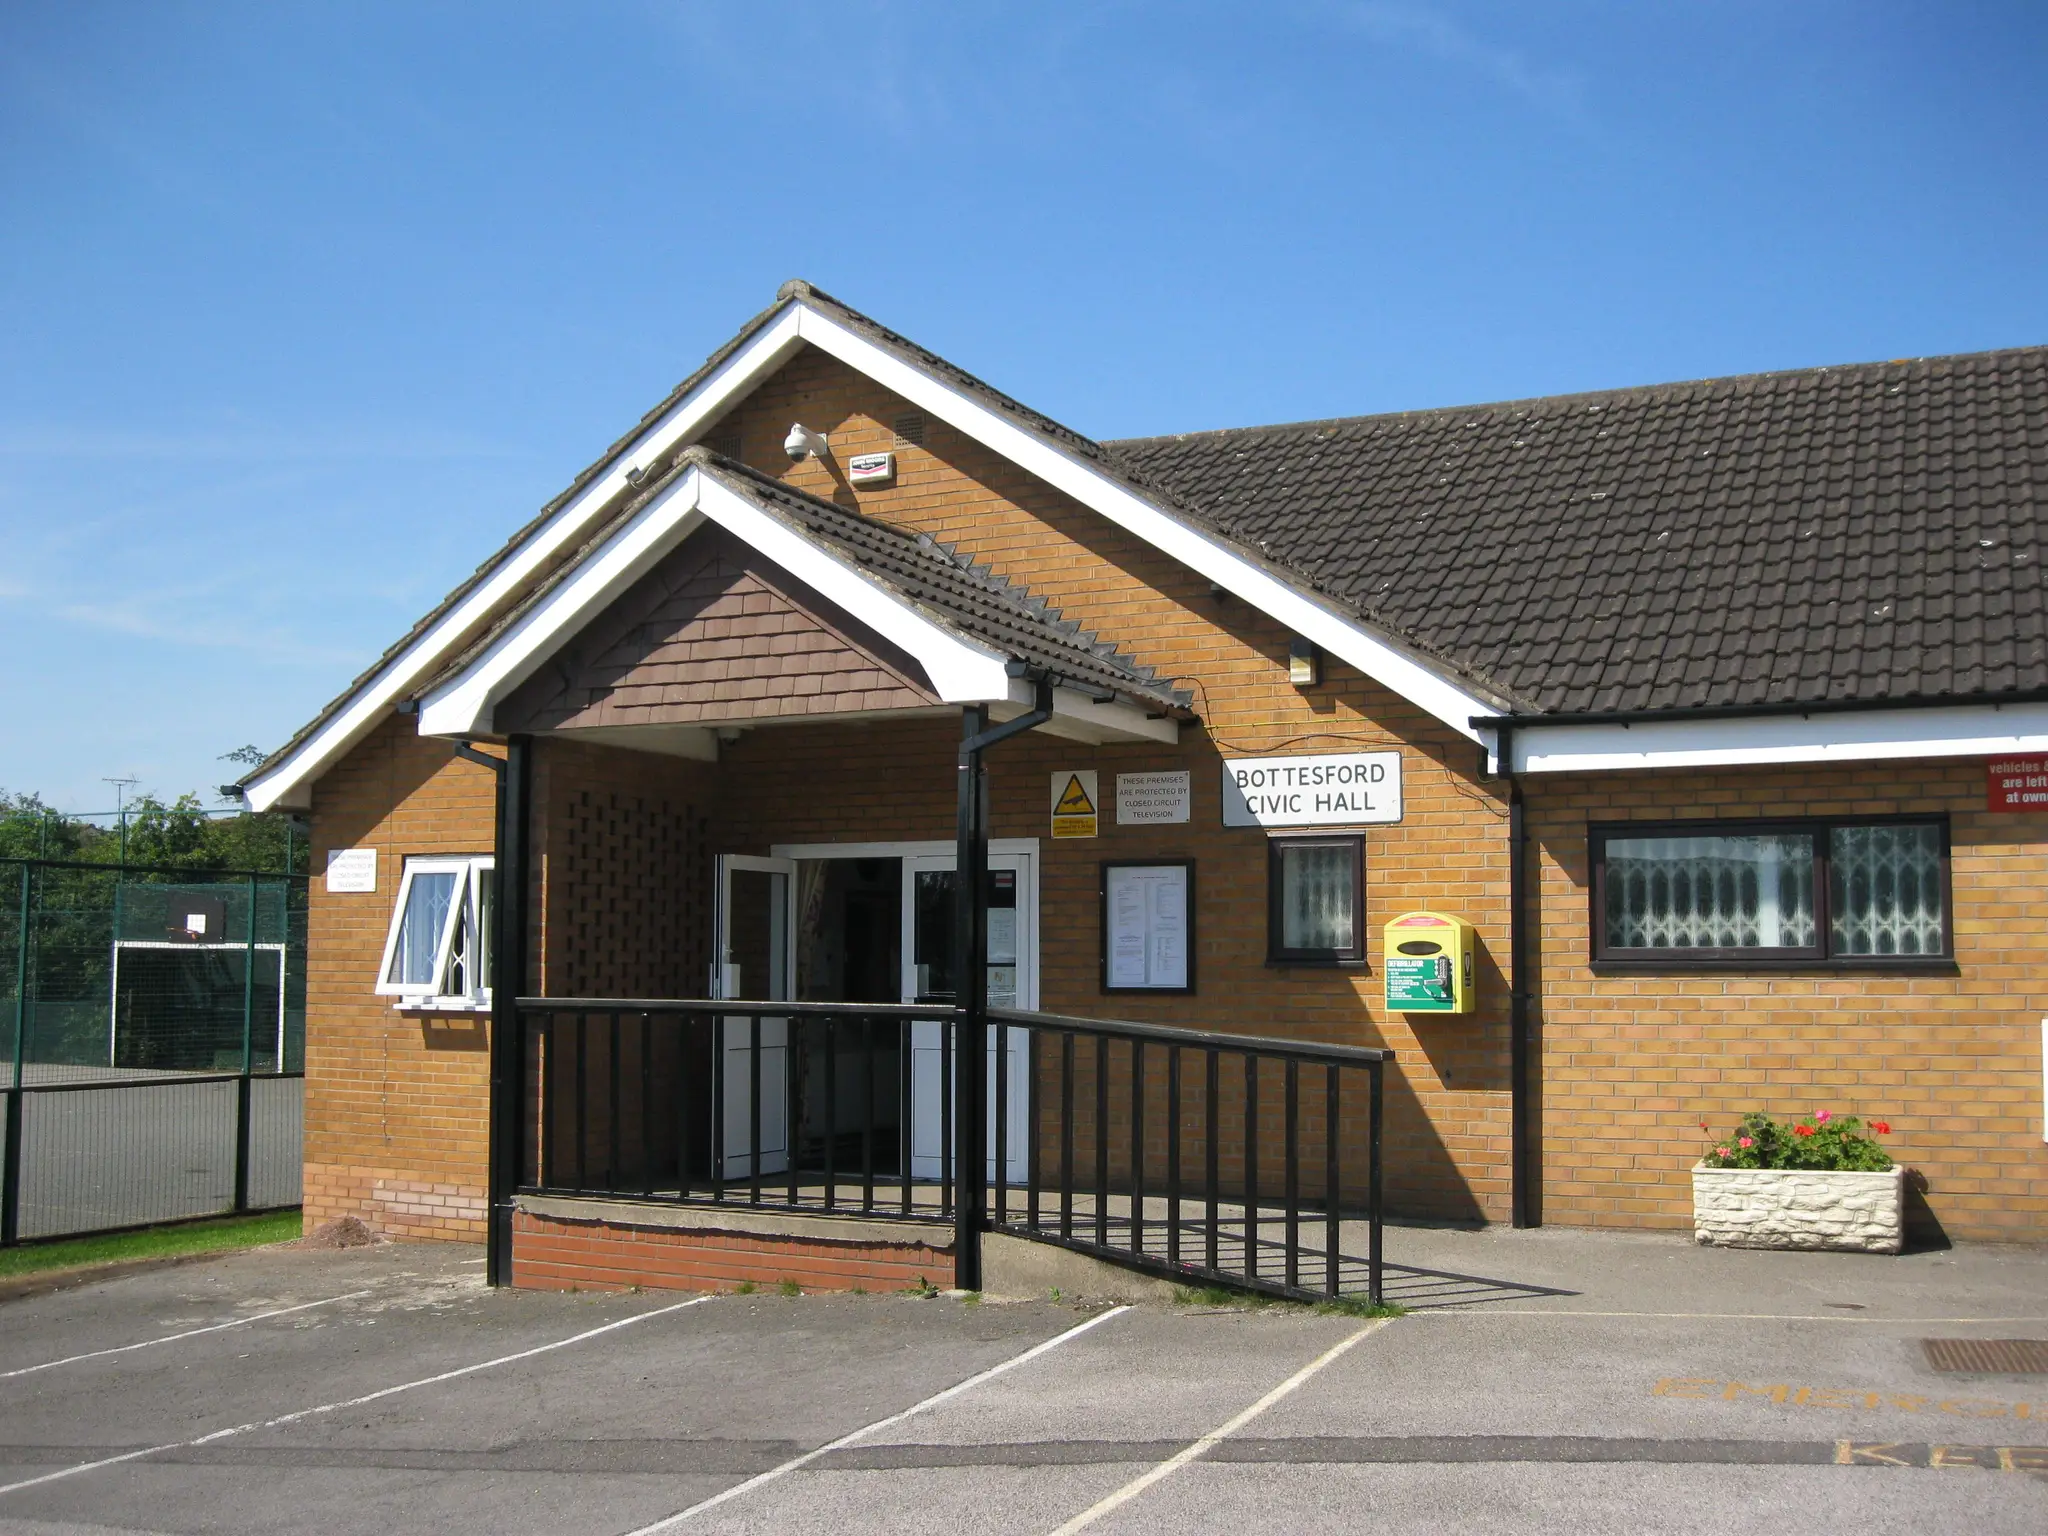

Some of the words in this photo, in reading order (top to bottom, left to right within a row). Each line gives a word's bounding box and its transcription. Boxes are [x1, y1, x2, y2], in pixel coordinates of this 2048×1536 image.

[1990, 761, 2040, 774] vehicles
[1147, 776, 1184, 784] PREMISES
[1236, 764, 1385, 788] BOTTESFORD
[2002, 779, 2023, 788] are
[2026, 776, 2048, 788] left
[1178, 787, 1187, 795] BY
[1246, 794, 1302, 815] CIVIC
[1315, 791, 1376, 812] HALL
[2006, 792, 2019, 803] at
[2022, 792, 2048, 803] own
